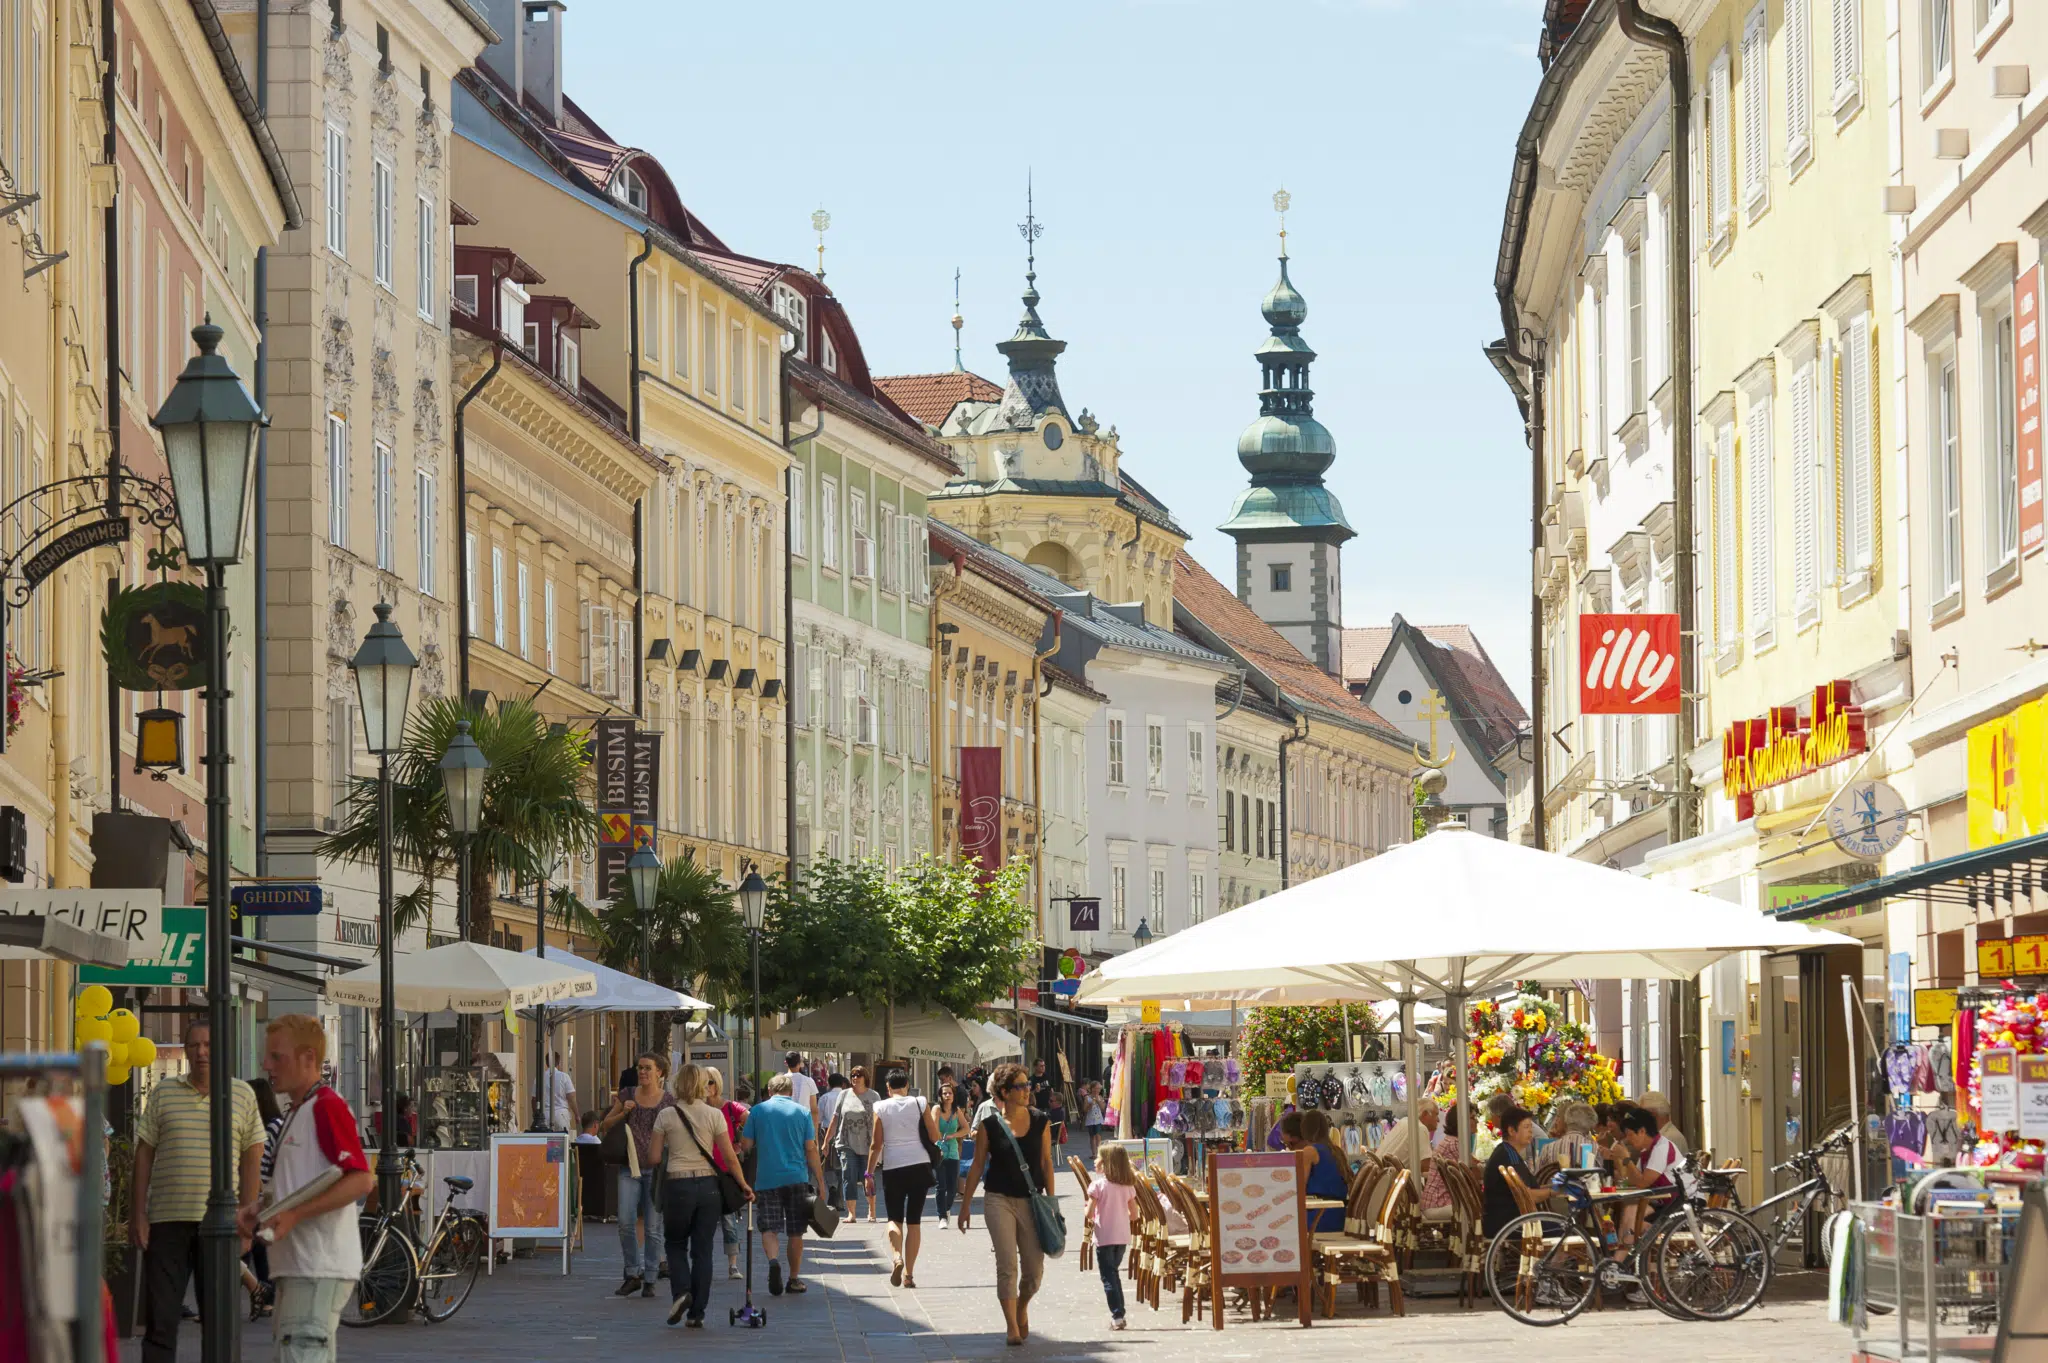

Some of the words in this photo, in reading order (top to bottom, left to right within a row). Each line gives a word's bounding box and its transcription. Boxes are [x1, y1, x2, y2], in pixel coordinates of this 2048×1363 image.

[27, 523, 125, 579] FREMDENZIMMER
[1586, 628, 1675, 704] illy
[608, 726, 626, 804] BESIM
[634, 740, 652, 816] BESIM
[243, 890, 311, 904] GHIDINI
[333, 990, 357, 1000] ALTER
[357, 993, 380, 1004] PLATZ
[457, 1000, 480, 1008] ALTER
[791, 1040, 838, 1050] RÖMERQUELLE
[919, 1047, 967, 1060] RÖMERQUELLE
